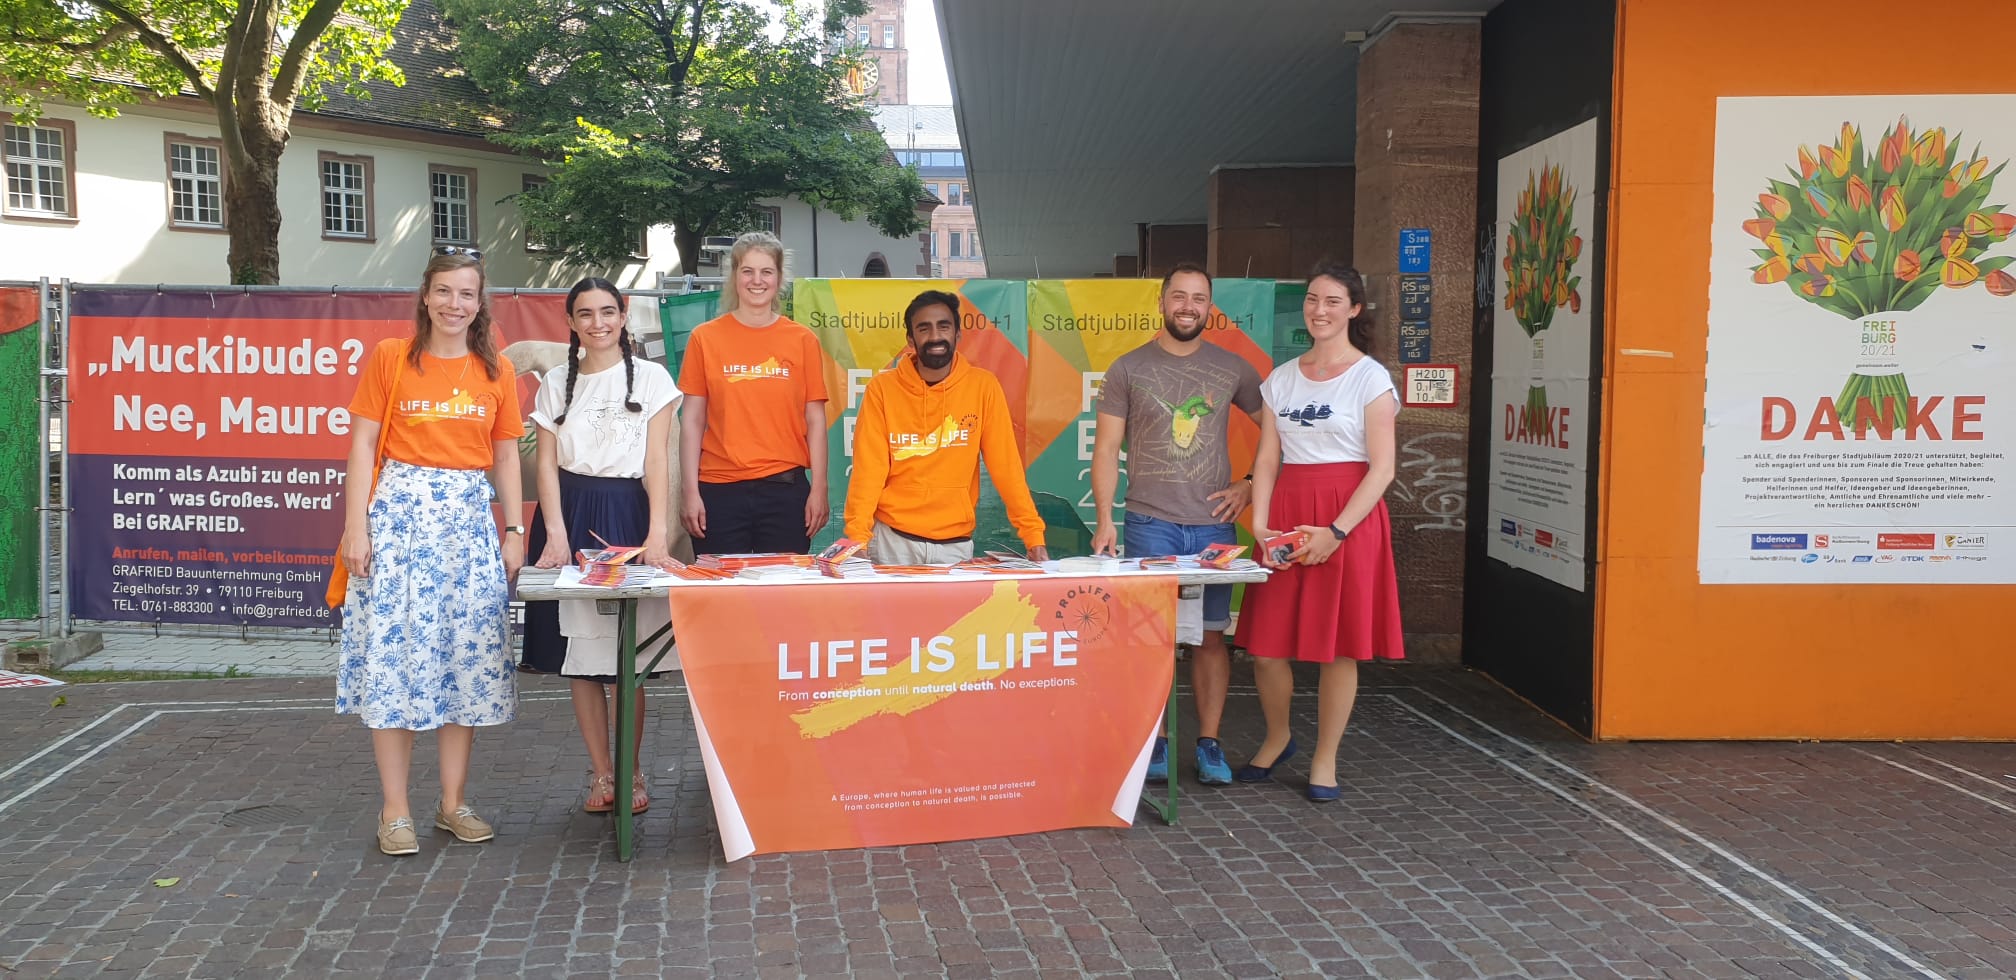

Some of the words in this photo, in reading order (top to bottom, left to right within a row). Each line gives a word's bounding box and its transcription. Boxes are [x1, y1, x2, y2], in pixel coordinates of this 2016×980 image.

[1401, 281, 1417, 292] RS
[809, 310, 909, 333] Stadtjubil
[963, 312, 1011, 331] 00+1
[1043, 312, 1163, 336] Stadtjubiläu
[1206, 312, 1254, 331] 00+1
[1401, 326, 1416, 336] RS
[1863, 320, 1896, 332] FREI
[1861, 332, 1896, 344] BURG
[1860, 344, 1896, 356] 20/21
[723, 364, 748, 373] LIFE
[751, 365, 762, 374] IS
[765, 367, 789, 377] LIFE
[1415, 369, 1445, 379] H200
[113, 394, 206, 440] Nee,
[220, 397, 350, 435] Maure
[399, 400, 430, 411] LIFE
[435, 401, 450, 412] IS
[455, 403, 486, 417] LIFE
[1760, 395, 1986, 441] DANKE
[1505, 403, 1570, 450] DANKE
[889, 432, 919, 444] LIFE
[941, 429, 968, 442] LIFE
[1803, 453, 1840, 461] Freiburger
[1926, 461, 1958, 469] gehalten
[113, 463, 171, 481] Komm
[175, 465, 203, 482] als
[206, 465, 257, 483] Azubi
[261, 471, 282, 484] zu
[286, 468, 319, 484] den
[325, 468, 347, 485] Pr
[169, 493, 205, 507] was
[209, 490, 279, 509] Großes.
[1866, 501, 1920, 509] DANKESCHÖN!
[113, 512, 142, 530] Bei
[146, 513, 245, 533] GRAFRIED.
[1756, 535, 1796, 543] badenova
[112, 546, 174, 563] Anrufen,
[177, 548, 230, 565] mailen,
[112, 564, 173, 578] GRAFRIED
[176, 566, 282, 584] Bauunternehmung
[286, 570, 321, 583] GmbH
[112, 581, 183, 597] Ziegelhofstr.
[186, 584, 199, 596] 39
[218, 585, 252, 598] 79110
[255, 586, 303, 601] Freiburg
[112, 599, 138, 611] TEL:
[141, 600, 214, 614] 0761-883300
[232, 603, 330, 618] info@grafried.de
[1055, 585, 1111, 619] PROLIFE
[778, 639, 888, 680] LIFE
[910, 635, 956, 673] IS
[977, 630, 1078, 670] LIFE
[778, 690, 809, 701] From
[812, 686, 881, 701] conception
[885, 685, 909, 697] until
[912, 682, 957, 695] natural
[960, 680, 997, 692] death.
[1000, 678, 1016, 689] No
[1018, 676, 1078, 690] exceptions.
[831, 794, 837, 802] A
[839, 793, 872, 803] Europe,
[874, 790, 898, 799] where
[900, 788, 927, 797] human
[929, 786, 943, 795] life
[944, 786, 951, 794] is
[953, 784, 980, 793] valued
[982, 782, 997, 791] and
[999, 780, 1036, 790] protected
[844, 803, 863, 812] from
[865, 800, 910, 811] conception
[912, 799, 920, 807] to
[922, 797, 951, 806] natural
[980, 793, 987, 801] is
[989, 791, 1024, 801] possible.
